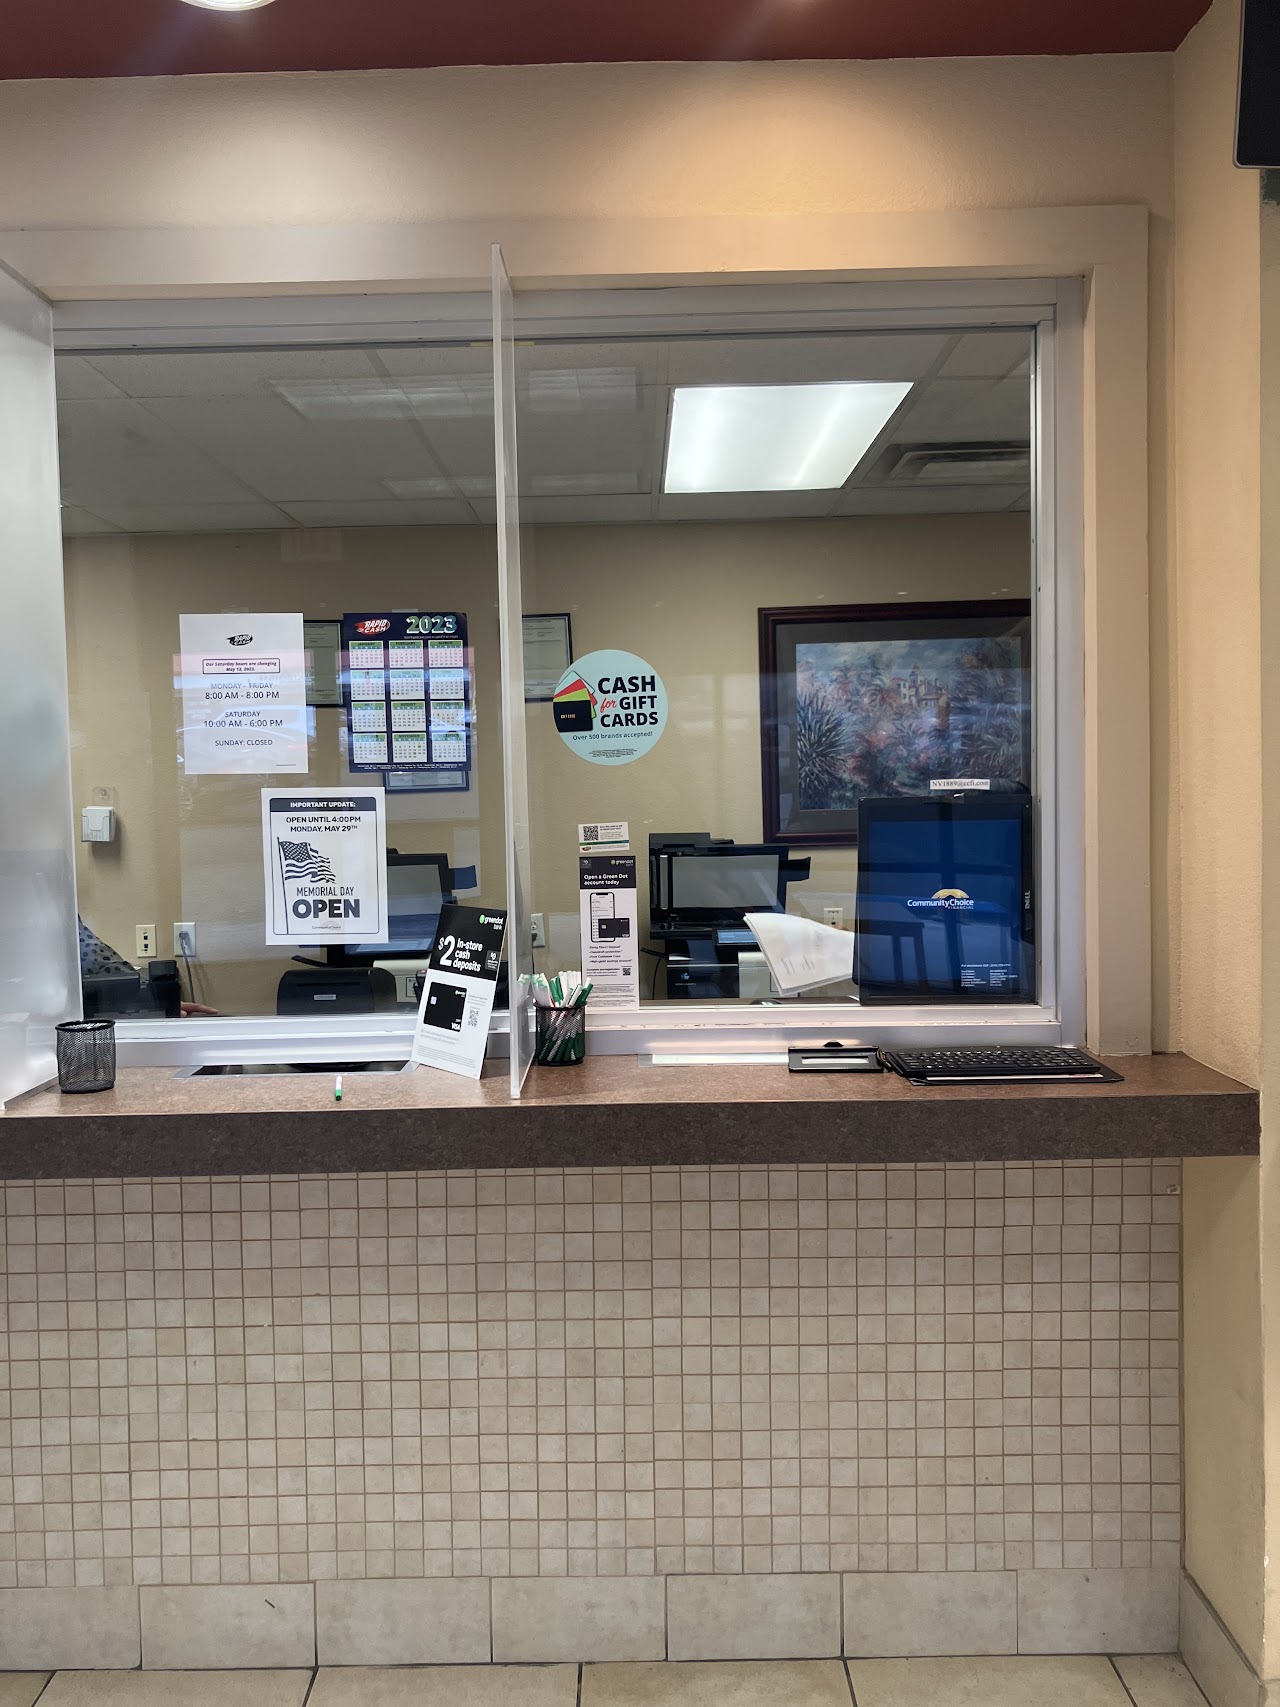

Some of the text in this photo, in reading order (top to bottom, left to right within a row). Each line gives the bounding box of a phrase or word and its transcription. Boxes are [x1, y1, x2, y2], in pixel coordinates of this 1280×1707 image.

[364, 619, 388, 628] RAPID
[406, 616, 457, 634] 2023
[598, 675, 655, 694] CASH
[600, 696, 657, 713] for GIFT
[600, 712, 658, 727] CARDS
[297, 887, 354, 896] MEMORIAL DAY
[293, 899, 360, 918] OPEN
[907, 899, 974, 908] CommunityChoice
[484, 916, 503, 925] greendot
[438, 935, 483, 966] $2 In-store
[455, 950, 470, 959] cash
[453, 958, 481, 972] deposits
